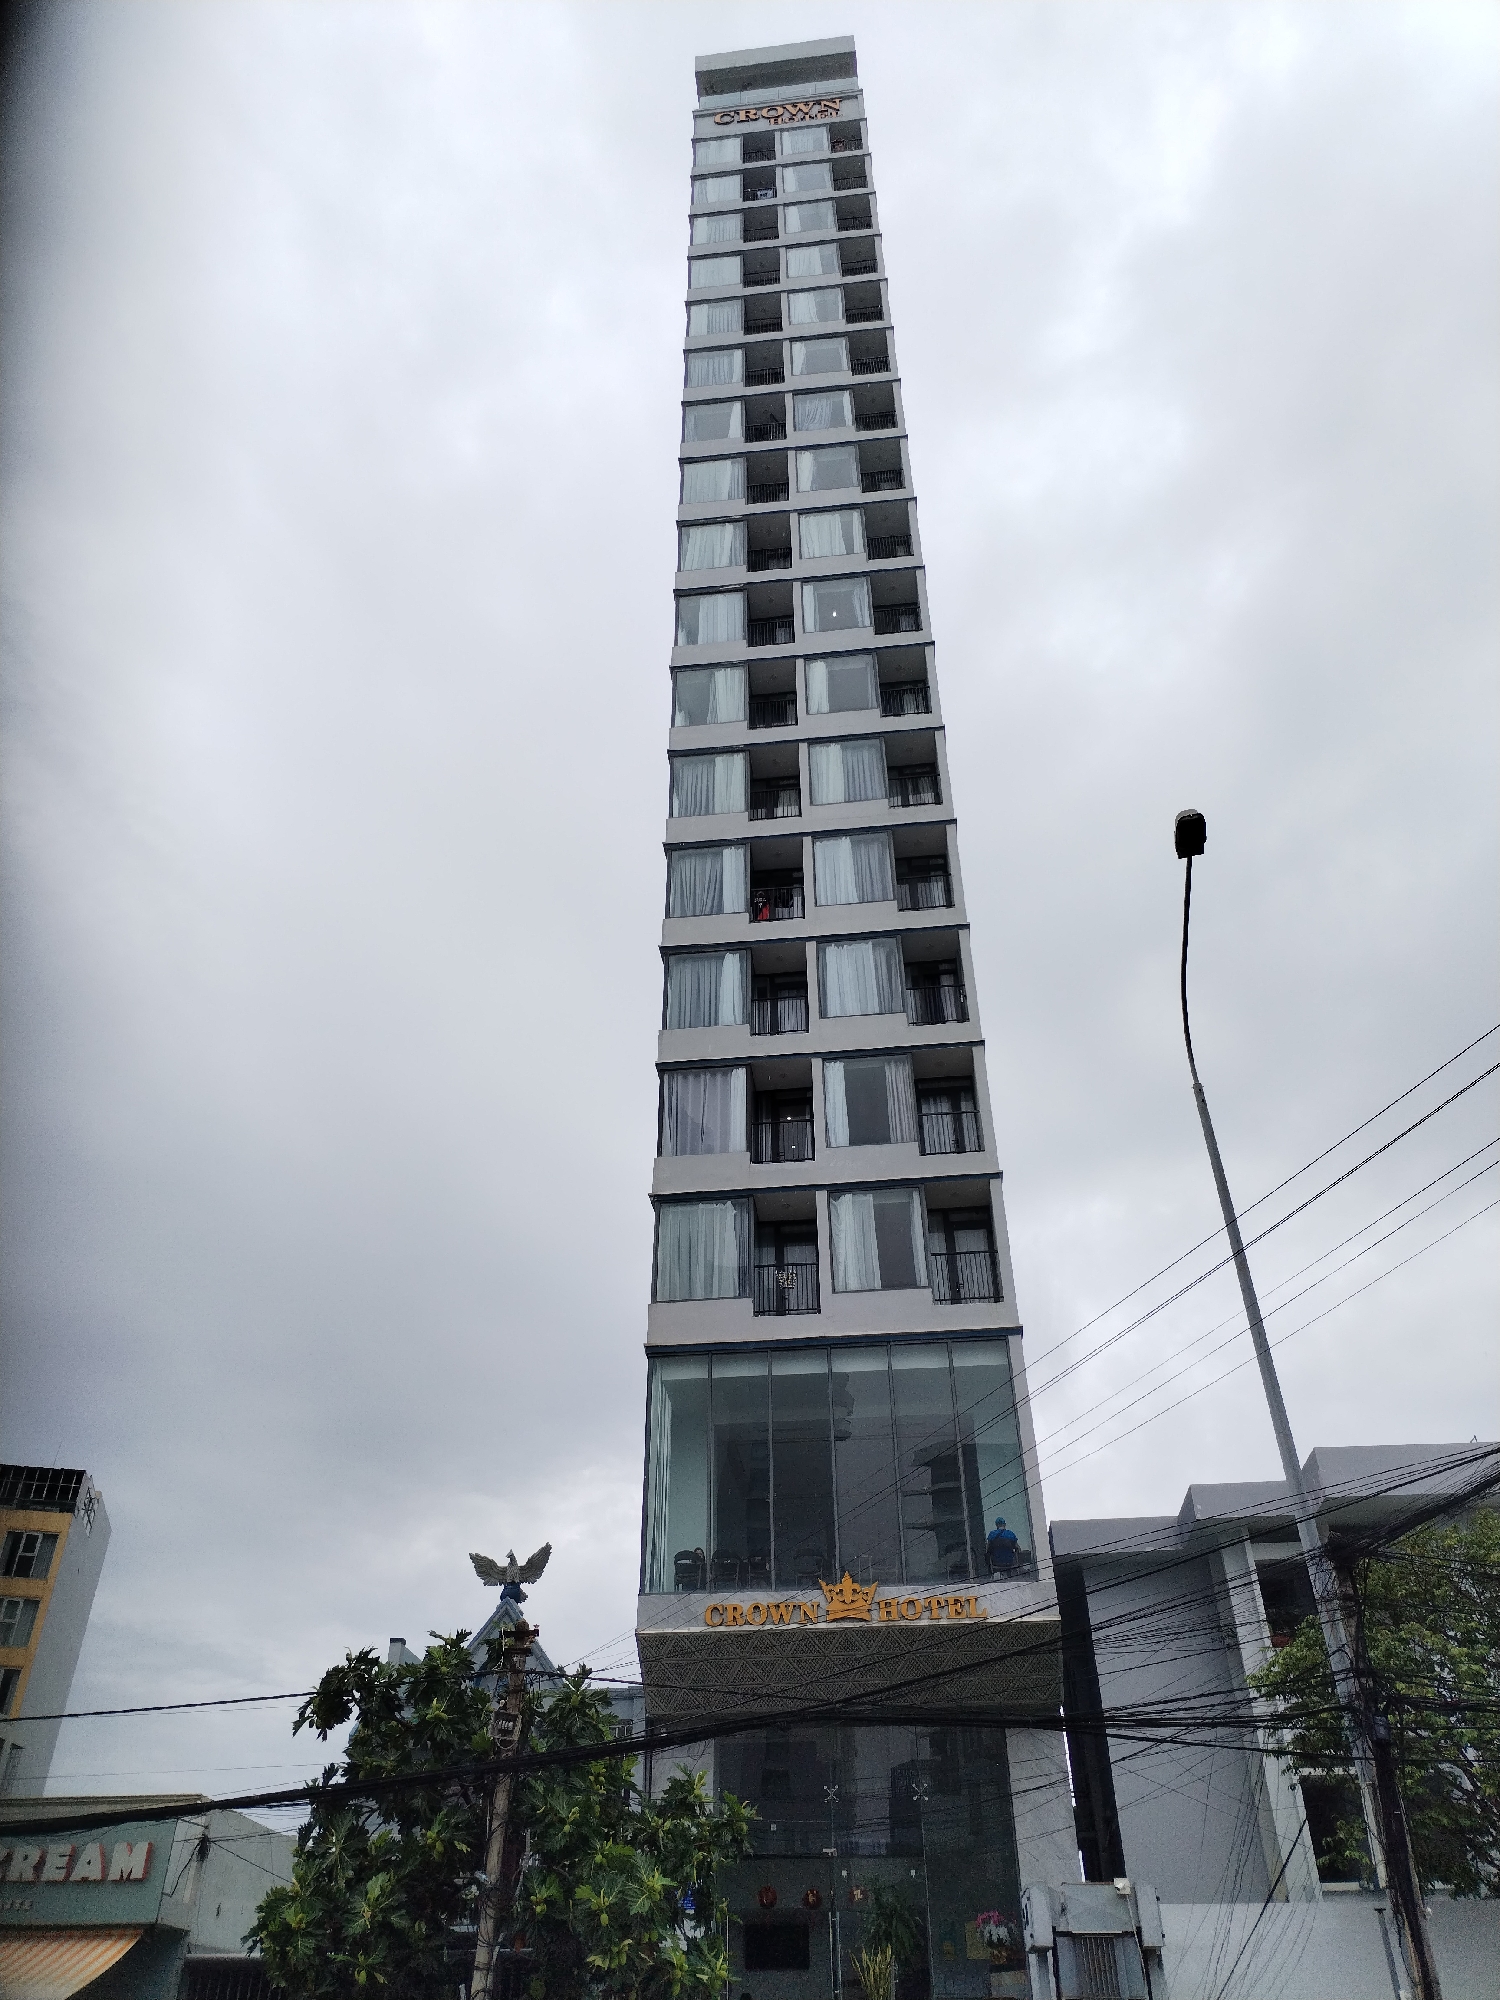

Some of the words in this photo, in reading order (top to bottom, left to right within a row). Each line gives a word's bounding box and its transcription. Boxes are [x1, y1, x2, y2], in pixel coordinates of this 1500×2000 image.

[714, 98, 842, 125] CROWN
[704, 1601, 820, 1627] CROWN
[878, 1596, 988, 1622] HOTEL
[0, 1841, 153, 1882] REAM
